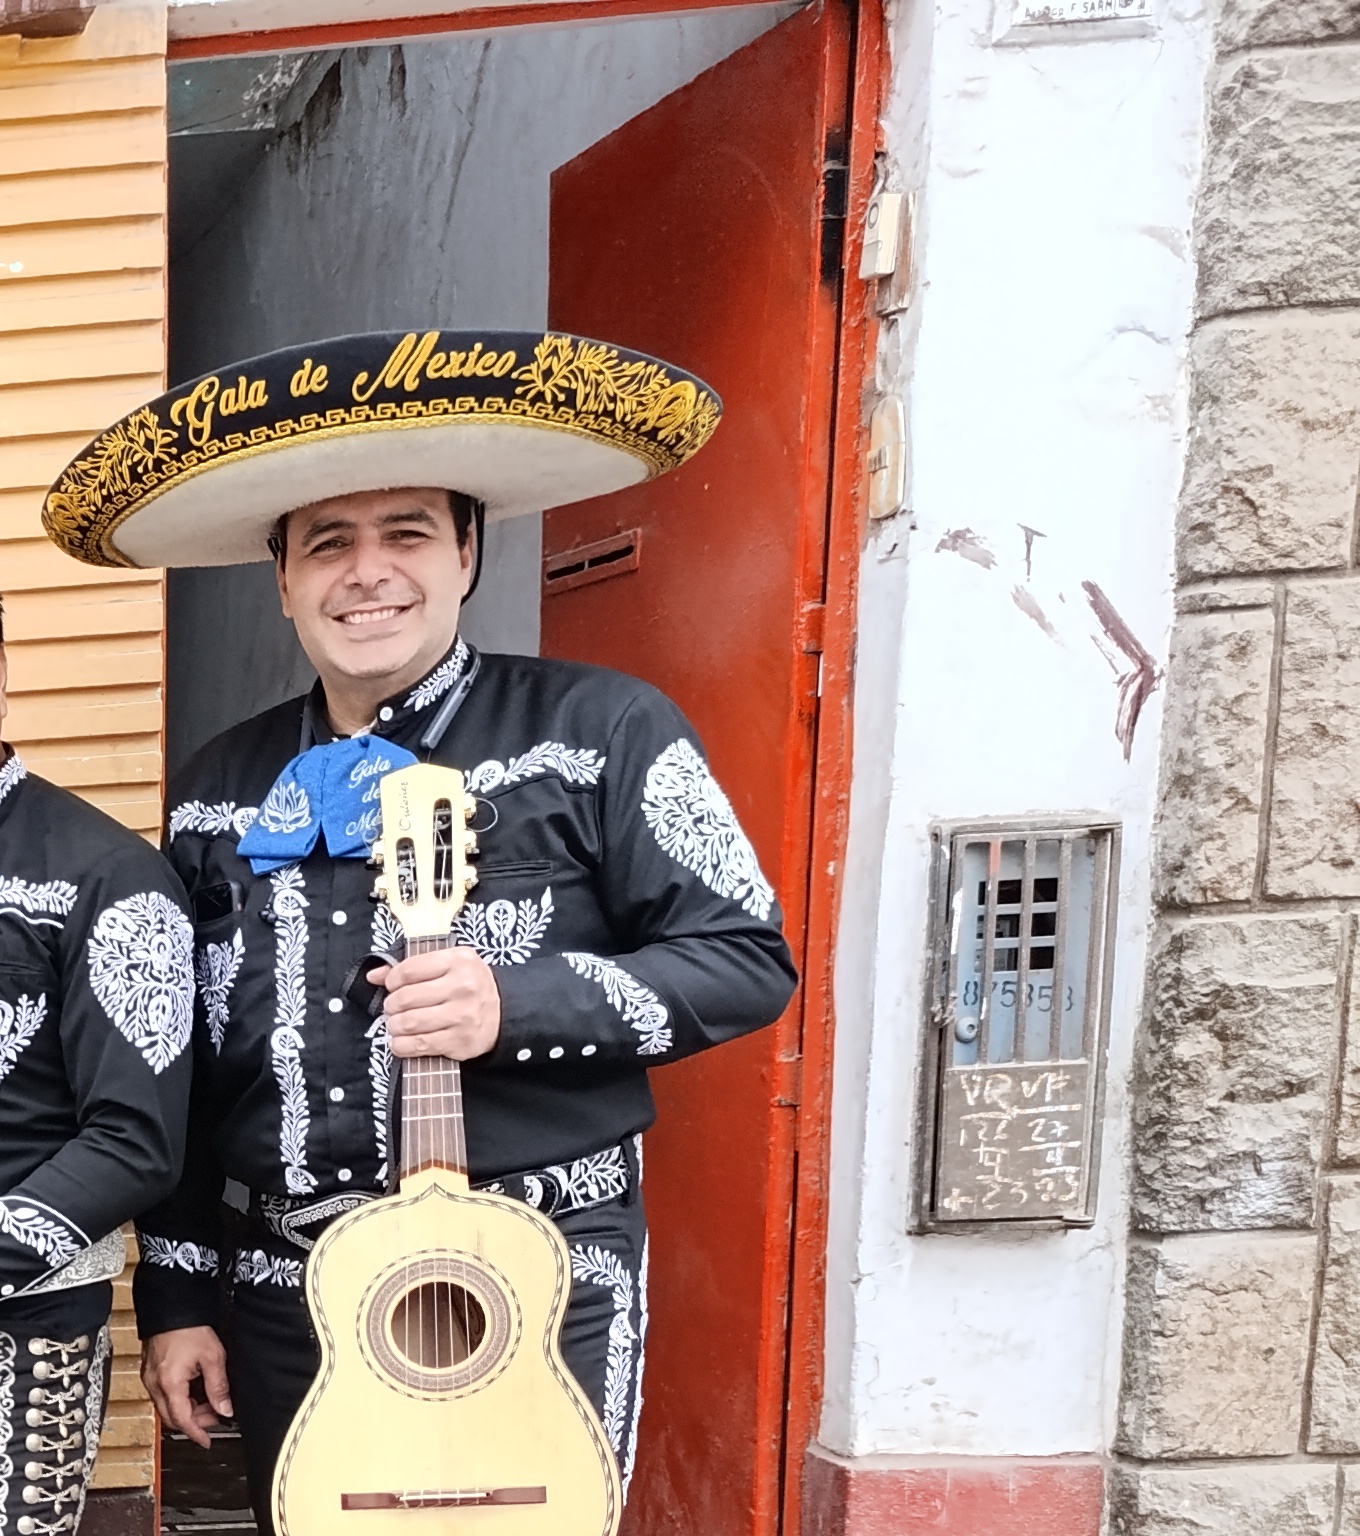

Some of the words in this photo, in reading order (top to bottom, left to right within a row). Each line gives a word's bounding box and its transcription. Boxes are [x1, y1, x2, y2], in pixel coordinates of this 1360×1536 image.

[171, 376, 268, 447] Gala
[290, 358, 329, 399] de
[353, 331, 518, 402] Mexico
[348, 755, 391, 789] Gala
[361, 782, 381, 804] de
